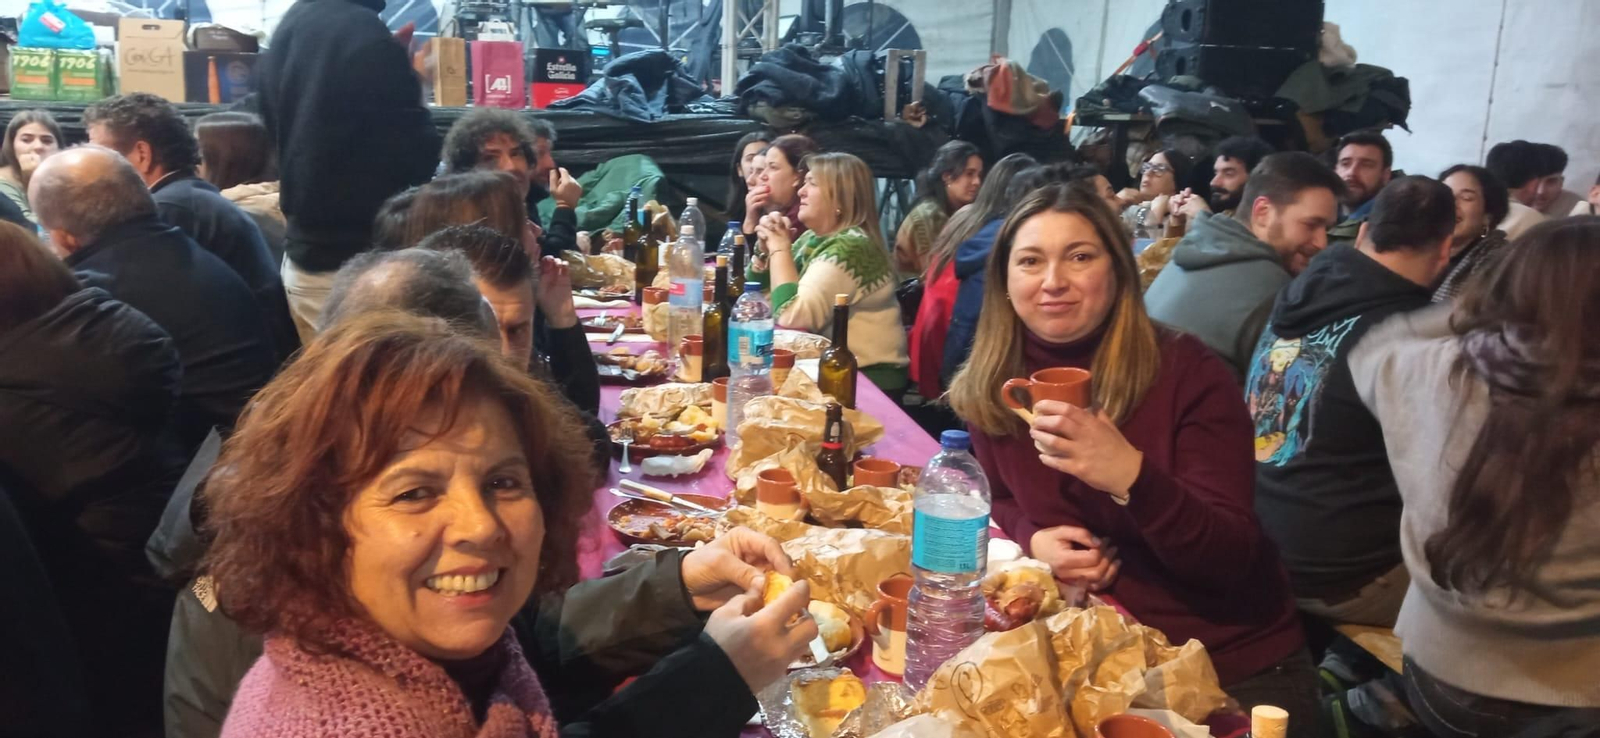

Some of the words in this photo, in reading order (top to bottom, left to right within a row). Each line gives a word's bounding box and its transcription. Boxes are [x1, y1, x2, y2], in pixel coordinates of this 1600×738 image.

[12, 53, 51, 67] 1906
[59, 55, 97, 69] 1906
[546, 62, 577, 71] Estrella
[547, 70, 576, 79] Galicia
